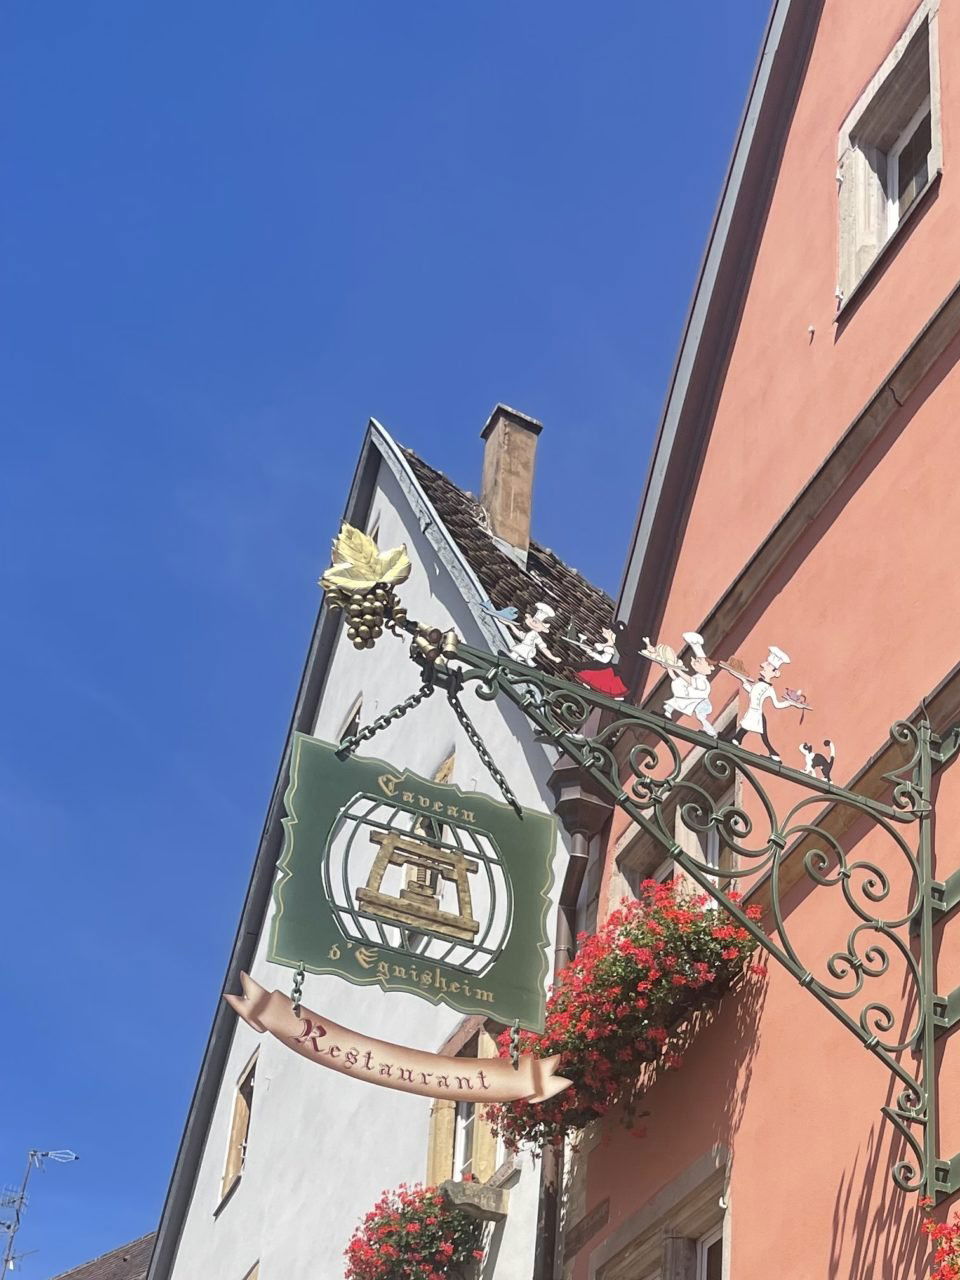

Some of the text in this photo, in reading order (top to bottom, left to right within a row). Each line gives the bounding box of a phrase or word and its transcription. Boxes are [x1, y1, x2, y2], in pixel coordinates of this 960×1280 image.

[377, 772, 477, 824] Caveau
[326, 942, 497, 1004] d'Eguisheim
[293, 1018, 492, 1091] Restaurant
